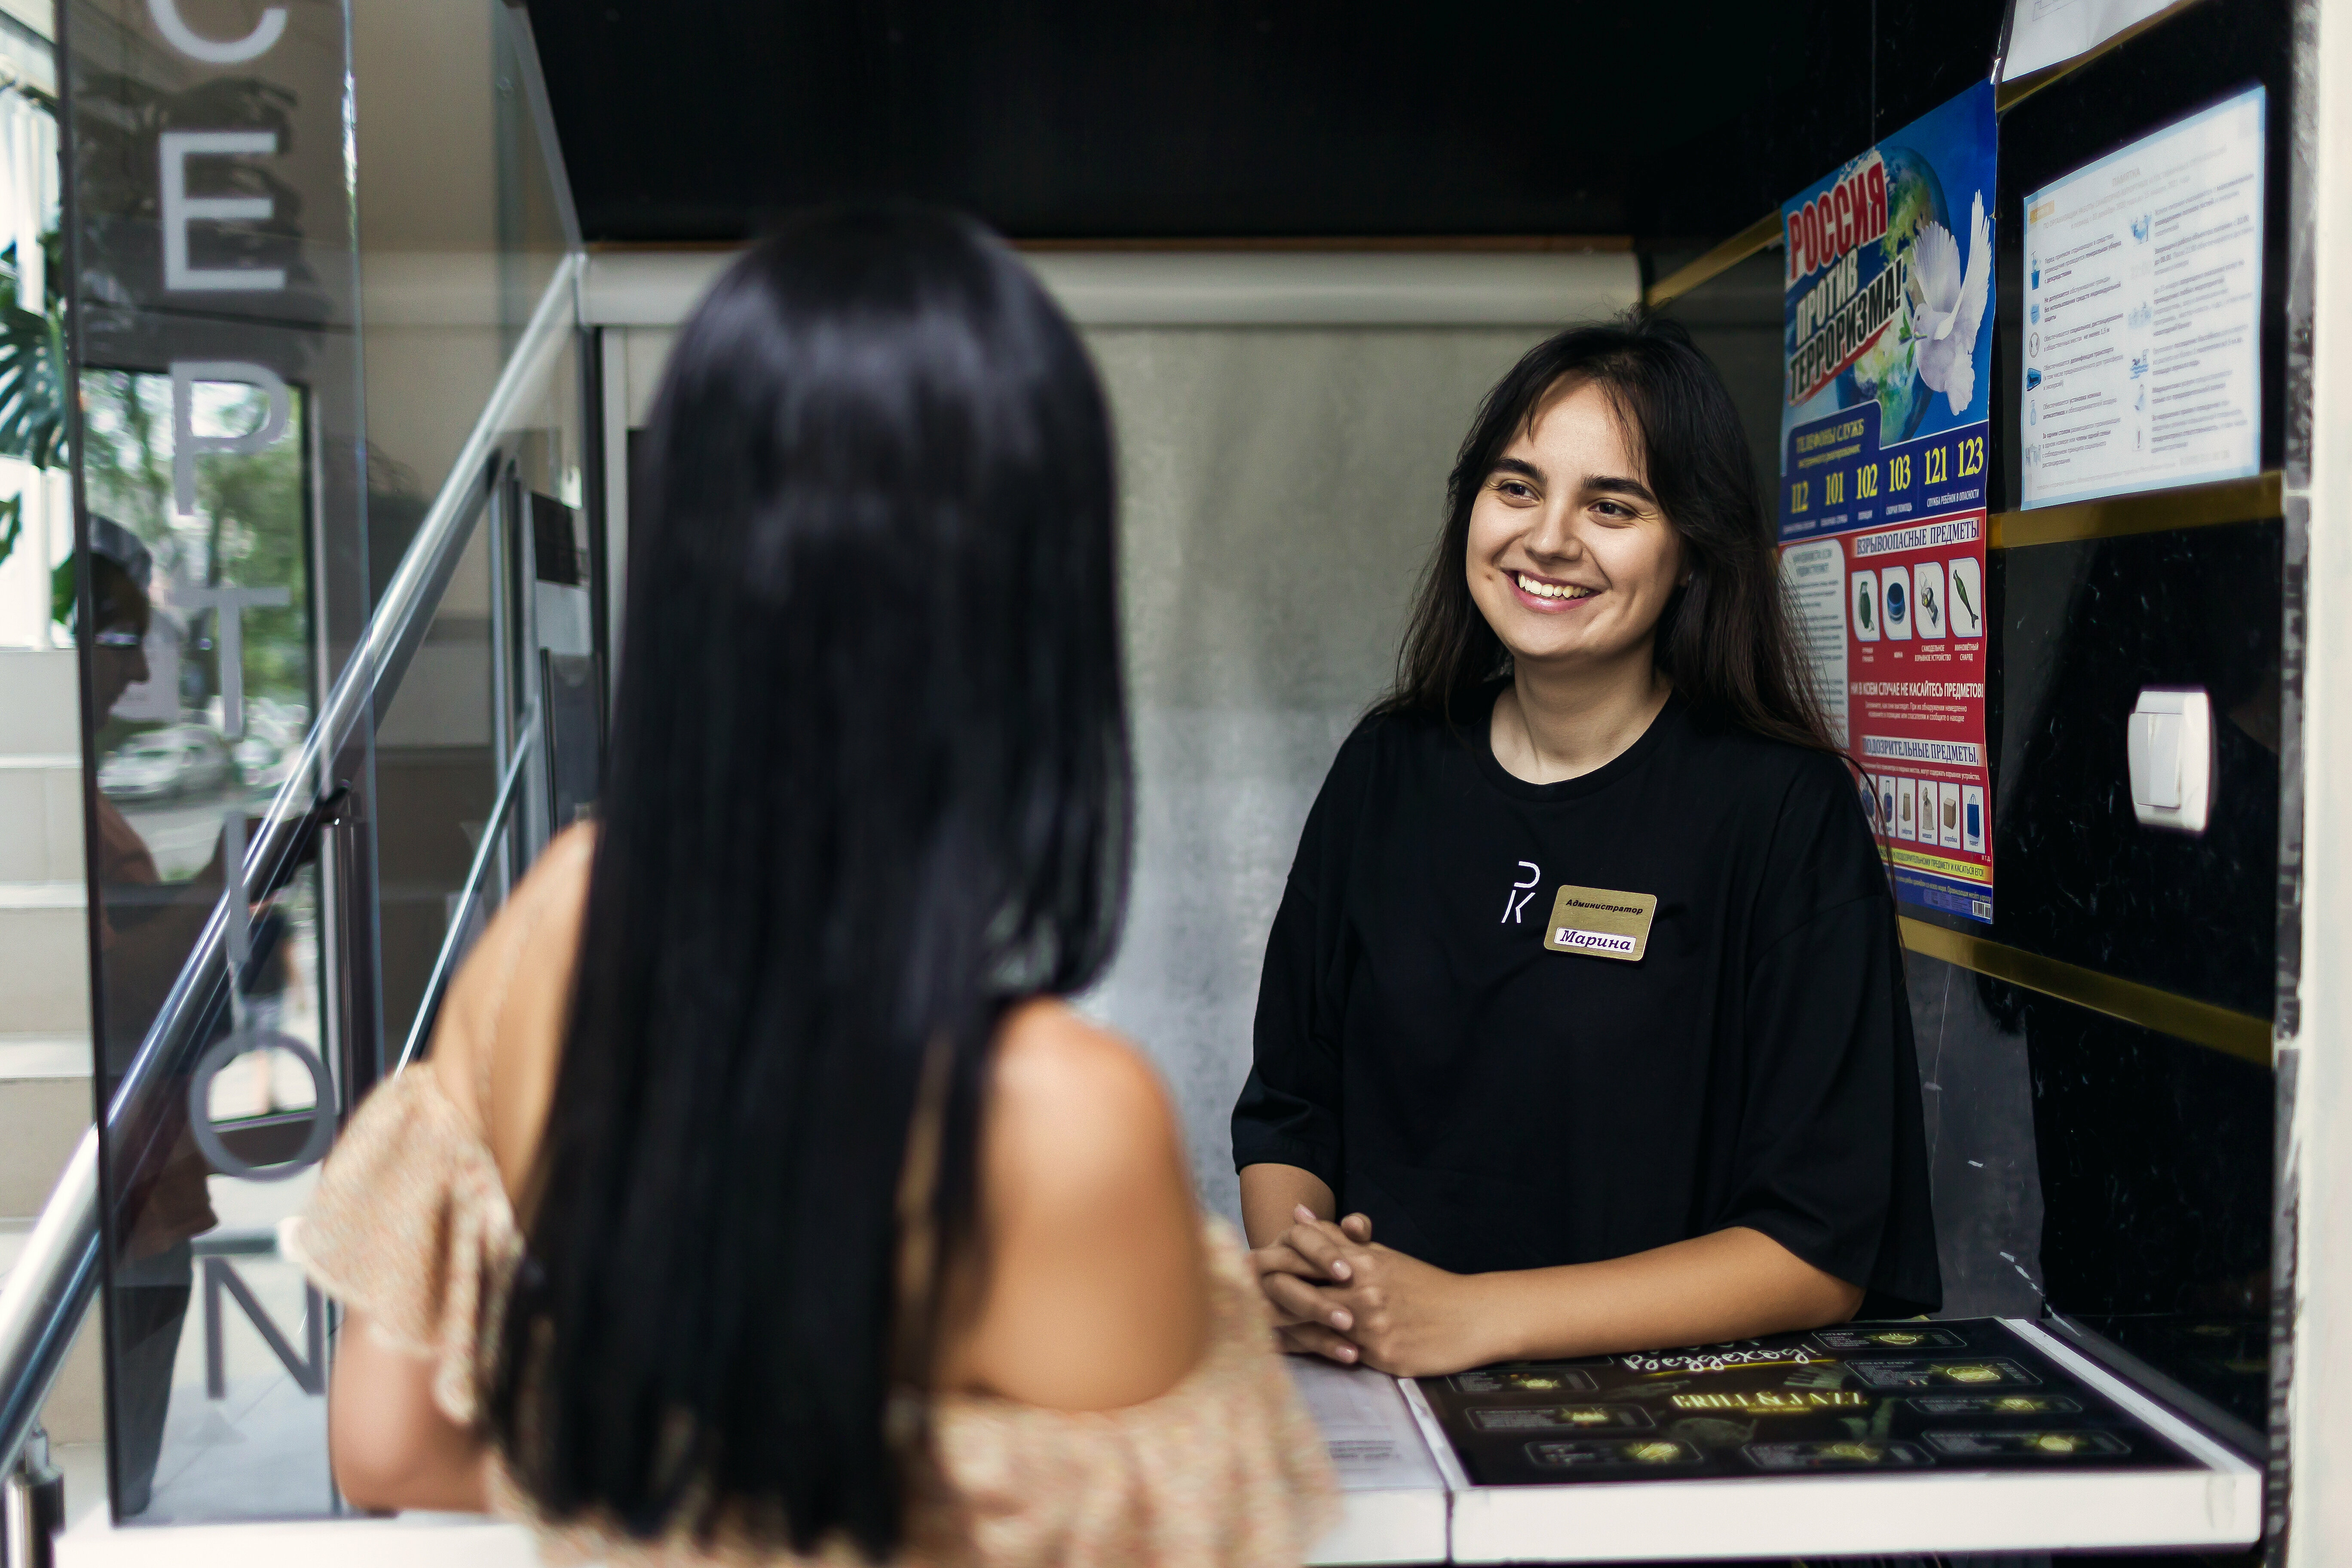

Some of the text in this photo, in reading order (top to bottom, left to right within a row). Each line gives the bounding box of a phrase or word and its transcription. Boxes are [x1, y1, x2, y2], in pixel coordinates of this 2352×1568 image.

[1788, 162, 1888, 281] РОССИЯ
[1797, 248, 1858, 346] ПРОТИВ
[1790, 257, 1903, 403] ТЕРРОРИЗМА!
[1889, 455, 1911, 492] 103
[1925, 446, 1947, 485] 121
[1958, 436, 1984, 478] 123
[1791, 480, 1809, 514] 112
[1825, 472, 1844, 505] 101
[1856, 463, 1878, 500] 102
[1857, 519, 1980, 555] ВЗРЫВООПАСНЫЕ ПРЕДМЕТЫ
[1879, 682, 1899, 696] СЛУЧАЕ
[1901, 682, 1908, 696] НЕ
[1909, 680, 1943, 697] КАСАЙТЕСЬ
[1944, 683, 1984, 700] ПРЕДМЕТОВ!
[1862, 738, 1978, 765] ПОДОЗРИТЕЛЬНЫЕ ПРЕДМЕТЫ,
[1931, 860, 1950, 871] ПРЕДМЕТУ
[1954, 864, 1974, 876] КАСАТЬСЯ
[1975, 868, 1984, 877] ЕГО!
[1566, 899, 1643, 915] Администратор
[1559, 930, 1631, 951] Марина
